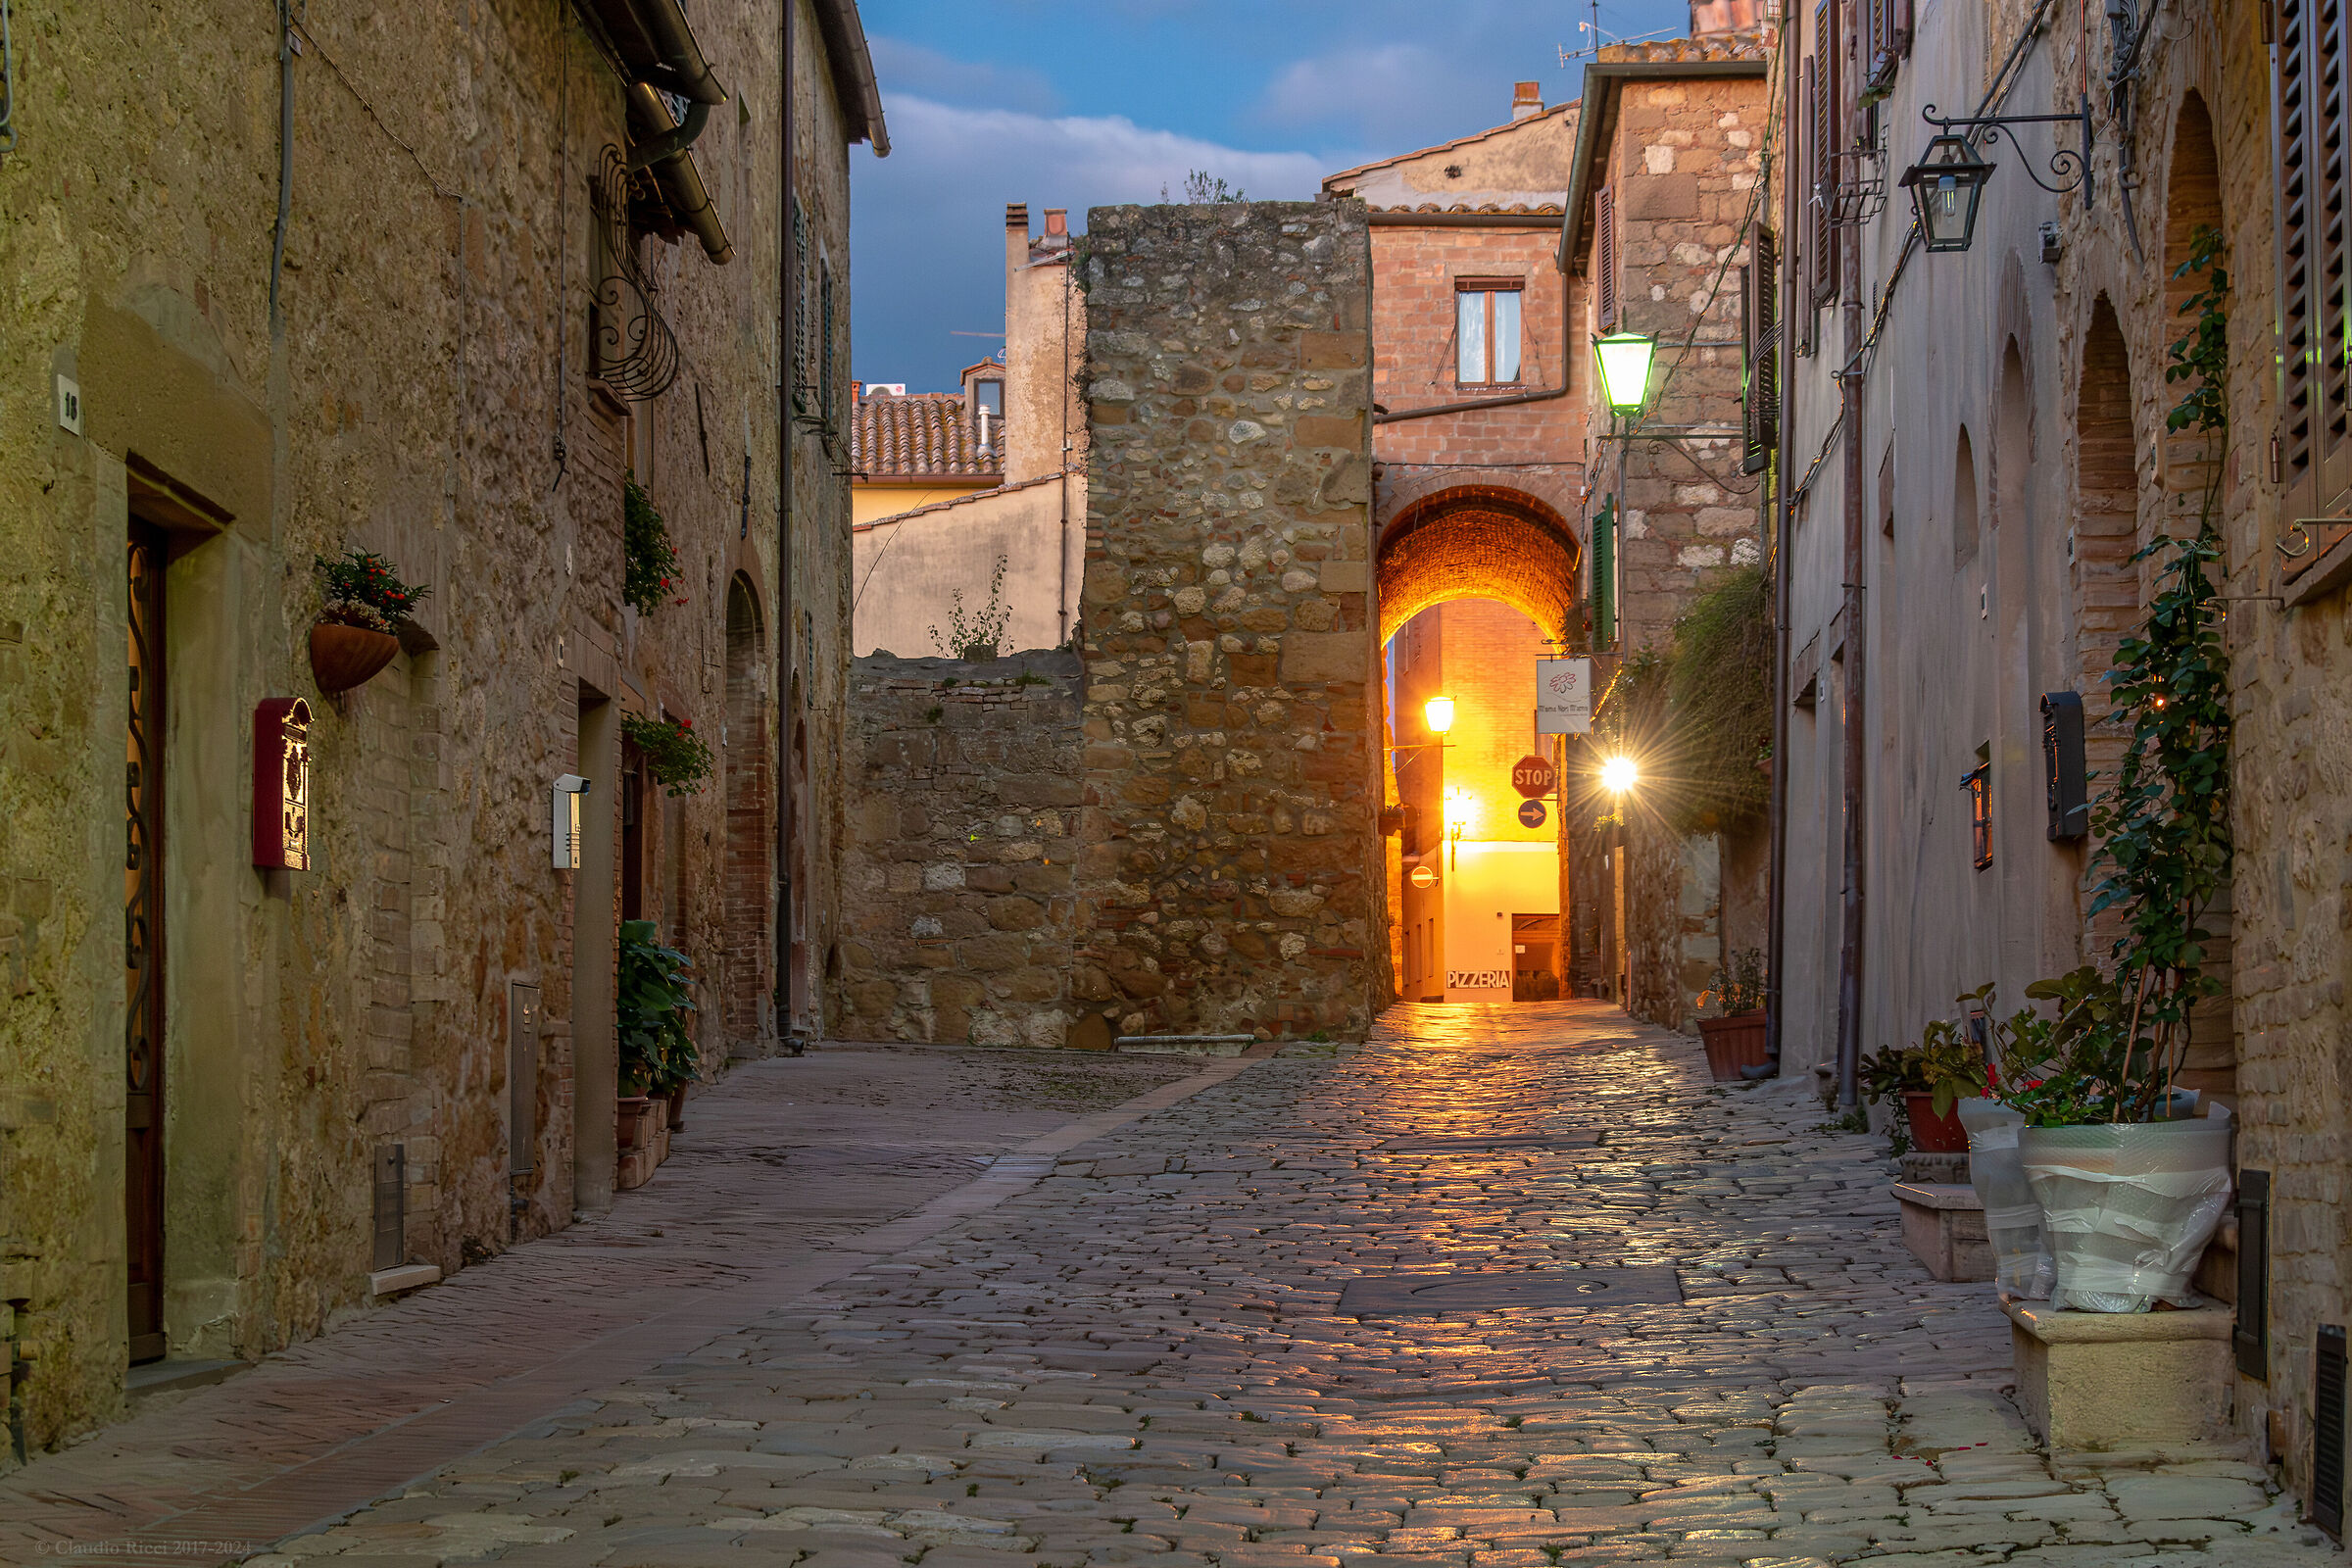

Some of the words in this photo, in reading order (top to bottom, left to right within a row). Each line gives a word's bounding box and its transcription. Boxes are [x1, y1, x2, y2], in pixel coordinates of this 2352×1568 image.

[65, 391, 77, 421] 18
[1515, 768, 1552, 786] STOP
[1446, 971, 1510, 988] PIZZERIA
